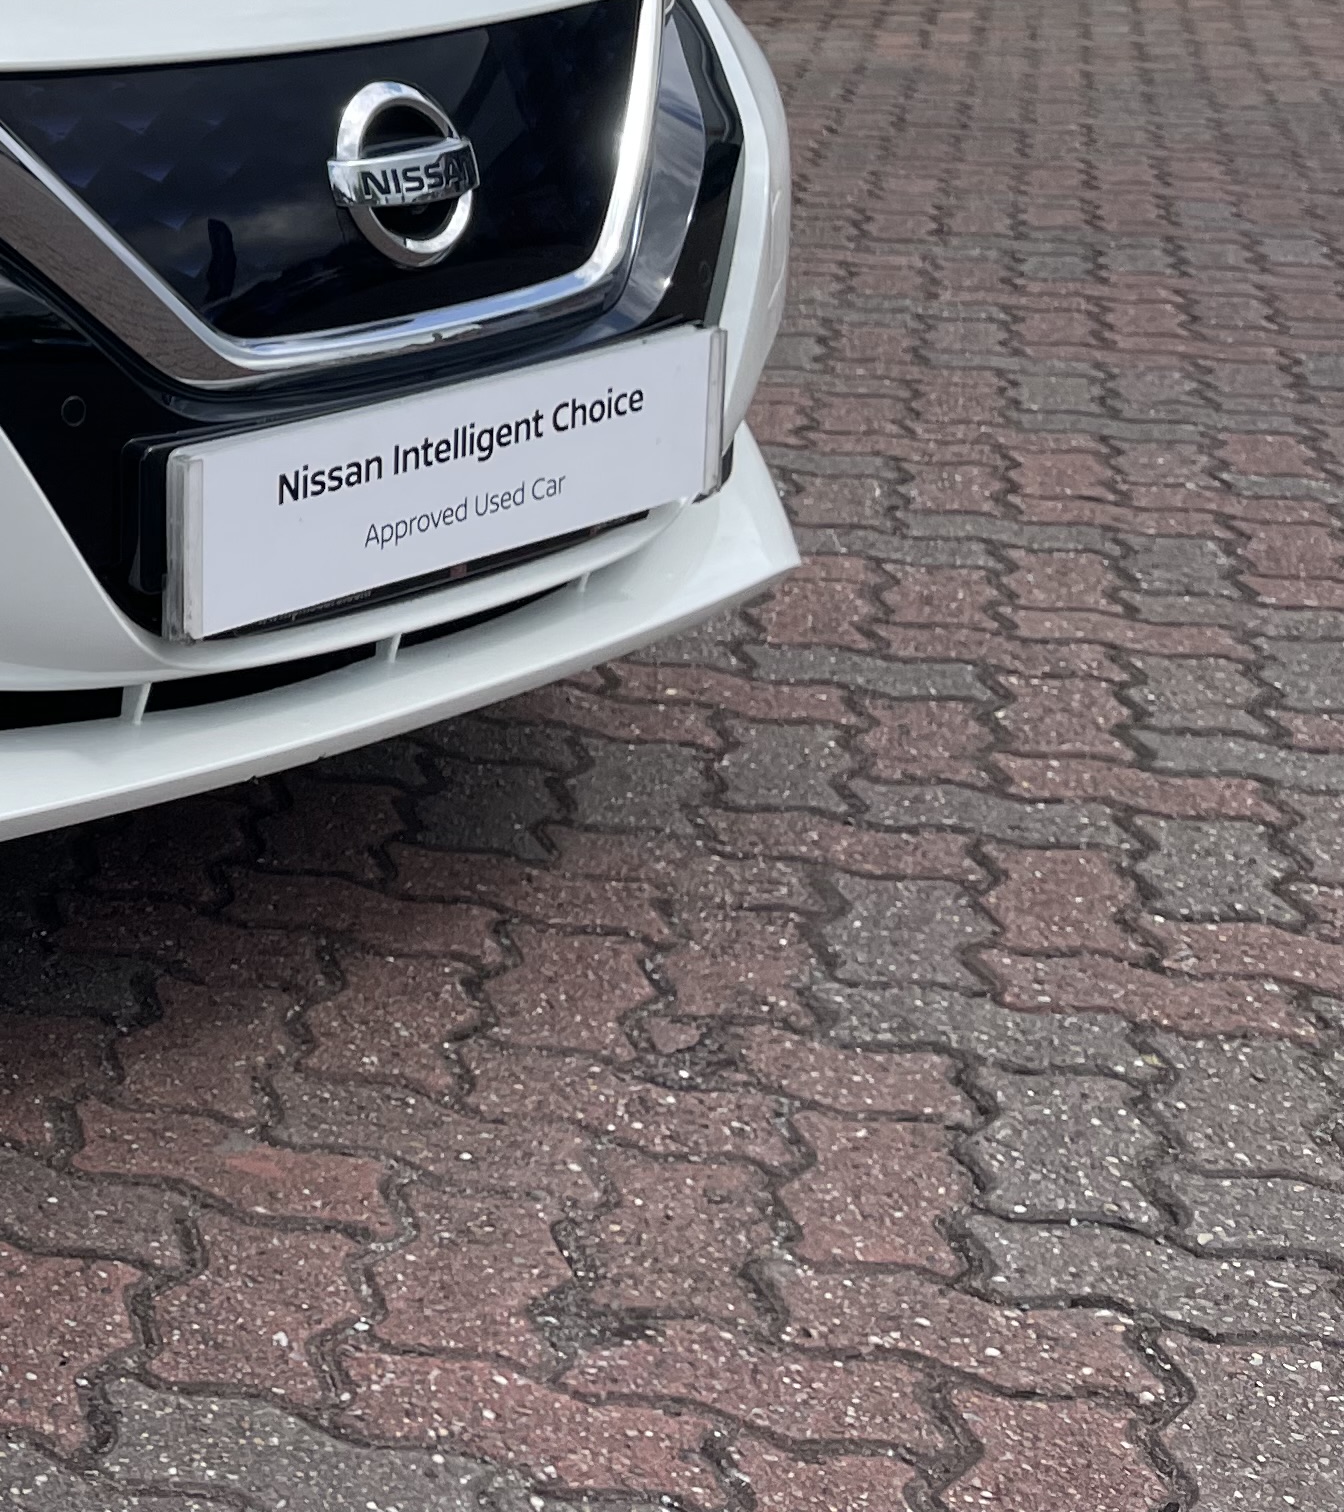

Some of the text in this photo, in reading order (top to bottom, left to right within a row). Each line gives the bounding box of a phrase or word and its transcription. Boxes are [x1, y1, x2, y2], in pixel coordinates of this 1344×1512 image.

[277, 386, 645, 506] Nissan Intelligent Choice
[364, 473, 567, 551] Approved Used Car
